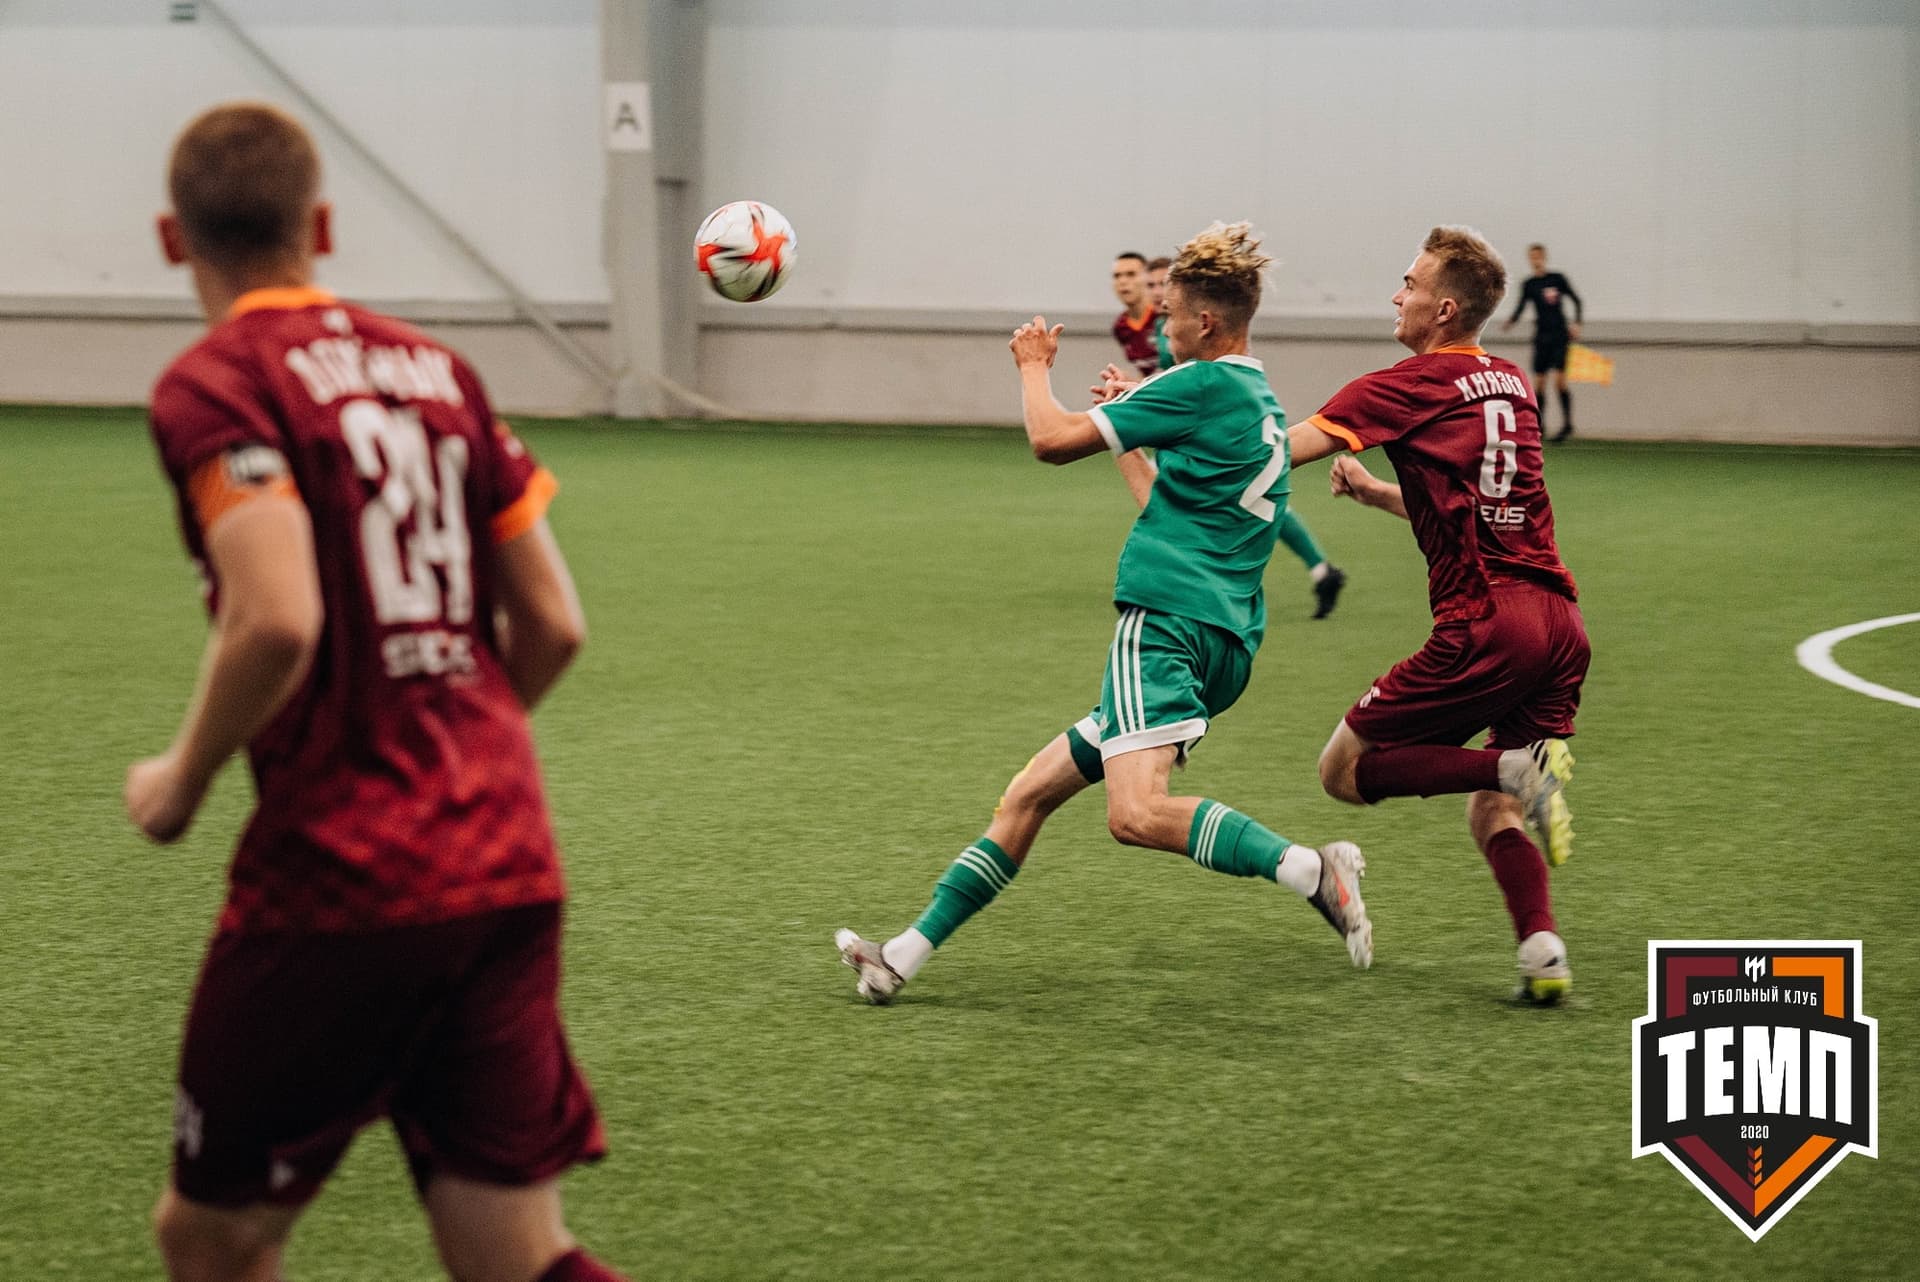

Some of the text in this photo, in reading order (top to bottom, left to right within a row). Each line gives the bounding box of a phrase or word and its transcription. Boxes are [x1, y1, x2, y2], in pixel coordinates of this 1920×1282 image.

[1238, 413, 1286, 522] 2
[1479, 399, 1517, 498] 6
[339, 398, 473, 624] 24
